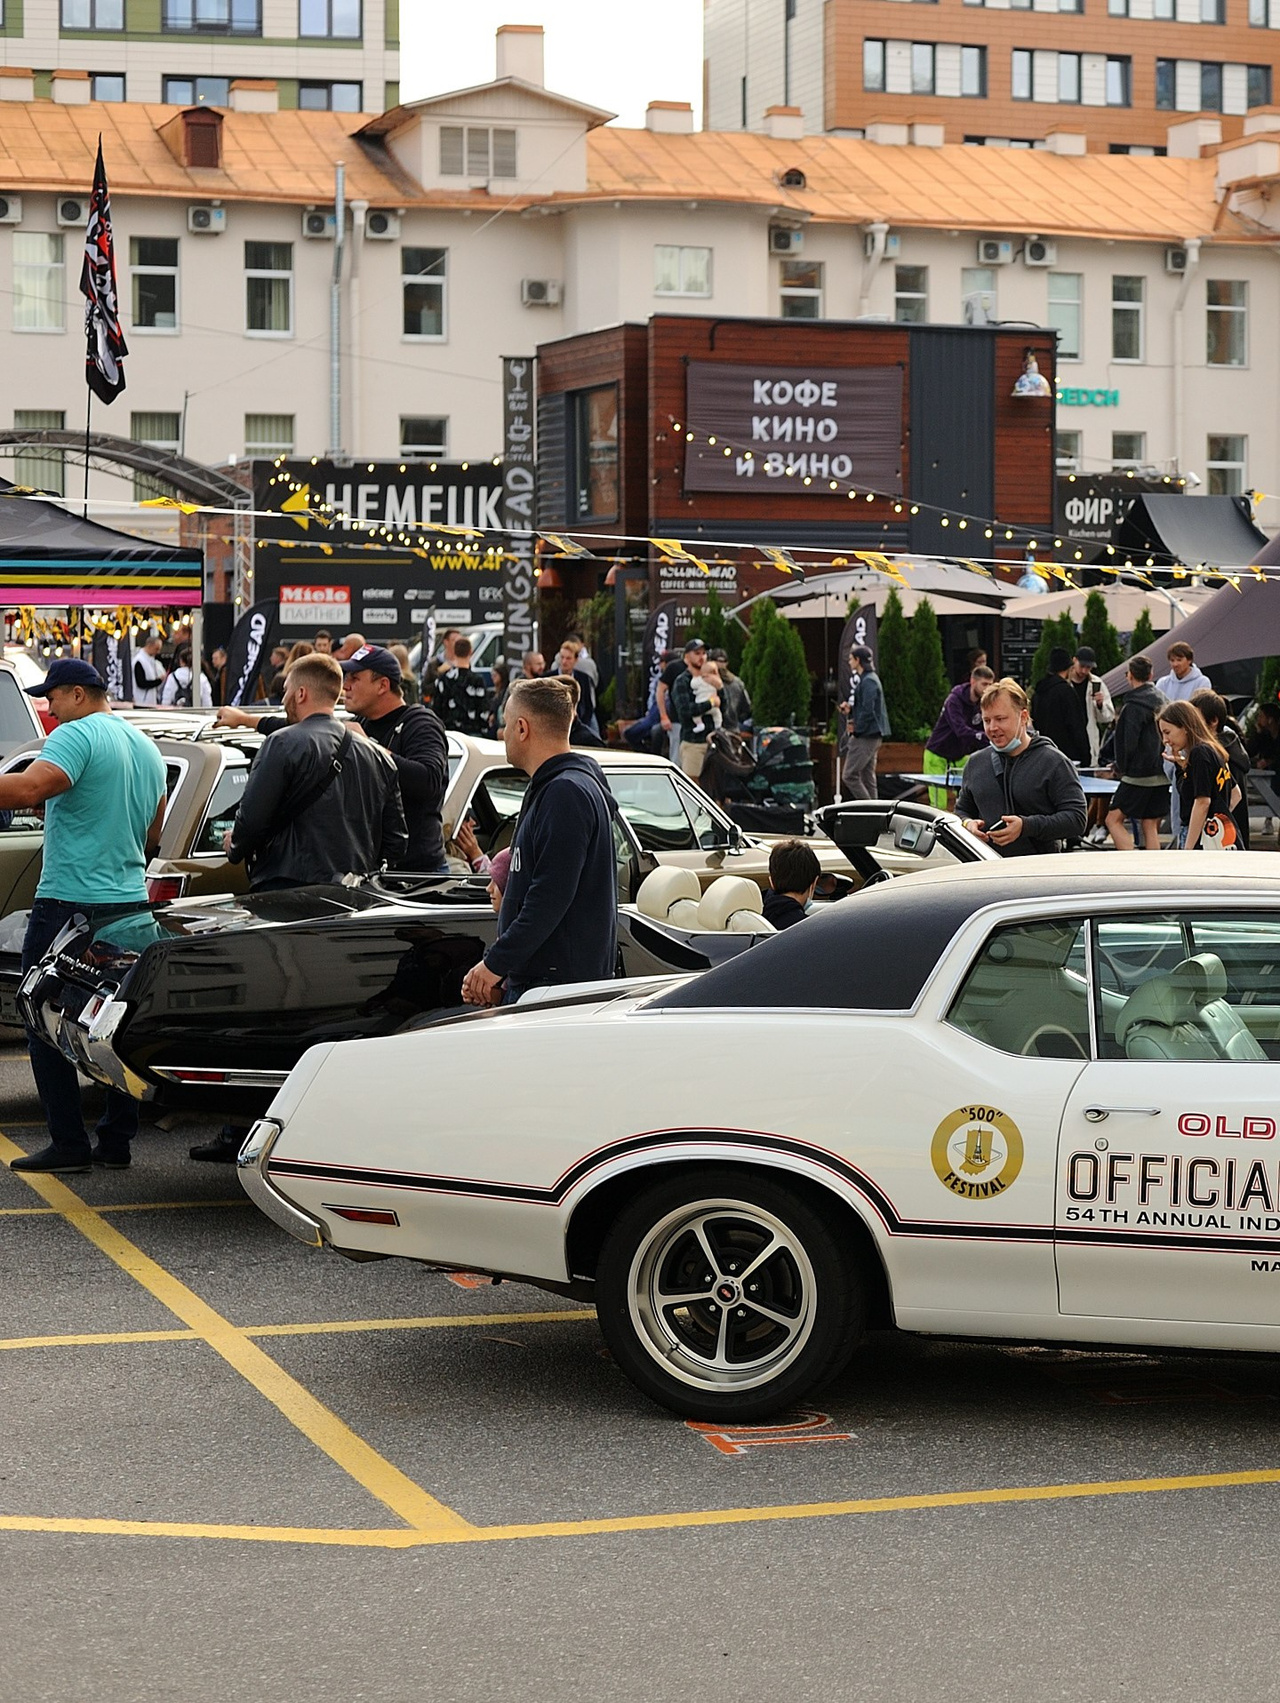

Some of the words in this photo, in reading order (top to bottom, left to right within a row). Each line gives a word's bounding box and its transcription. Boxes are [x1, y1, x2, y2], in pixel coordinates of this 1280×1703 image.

[753, 379, 838, 407] КОФЕ
[752, 415, 838, 443] КИНО
[766, 452, 853, 479] ВИНО
[281, 587, 349, 603] Miele
[285, 606, 344, 618] ПАРТНЕР
[943, 1171, 1006, 1197] FESTIVAL
[1065, 1207, 1129, 1224] 54TH
[1136, 1211, 1231, 1229] ANNUAL
